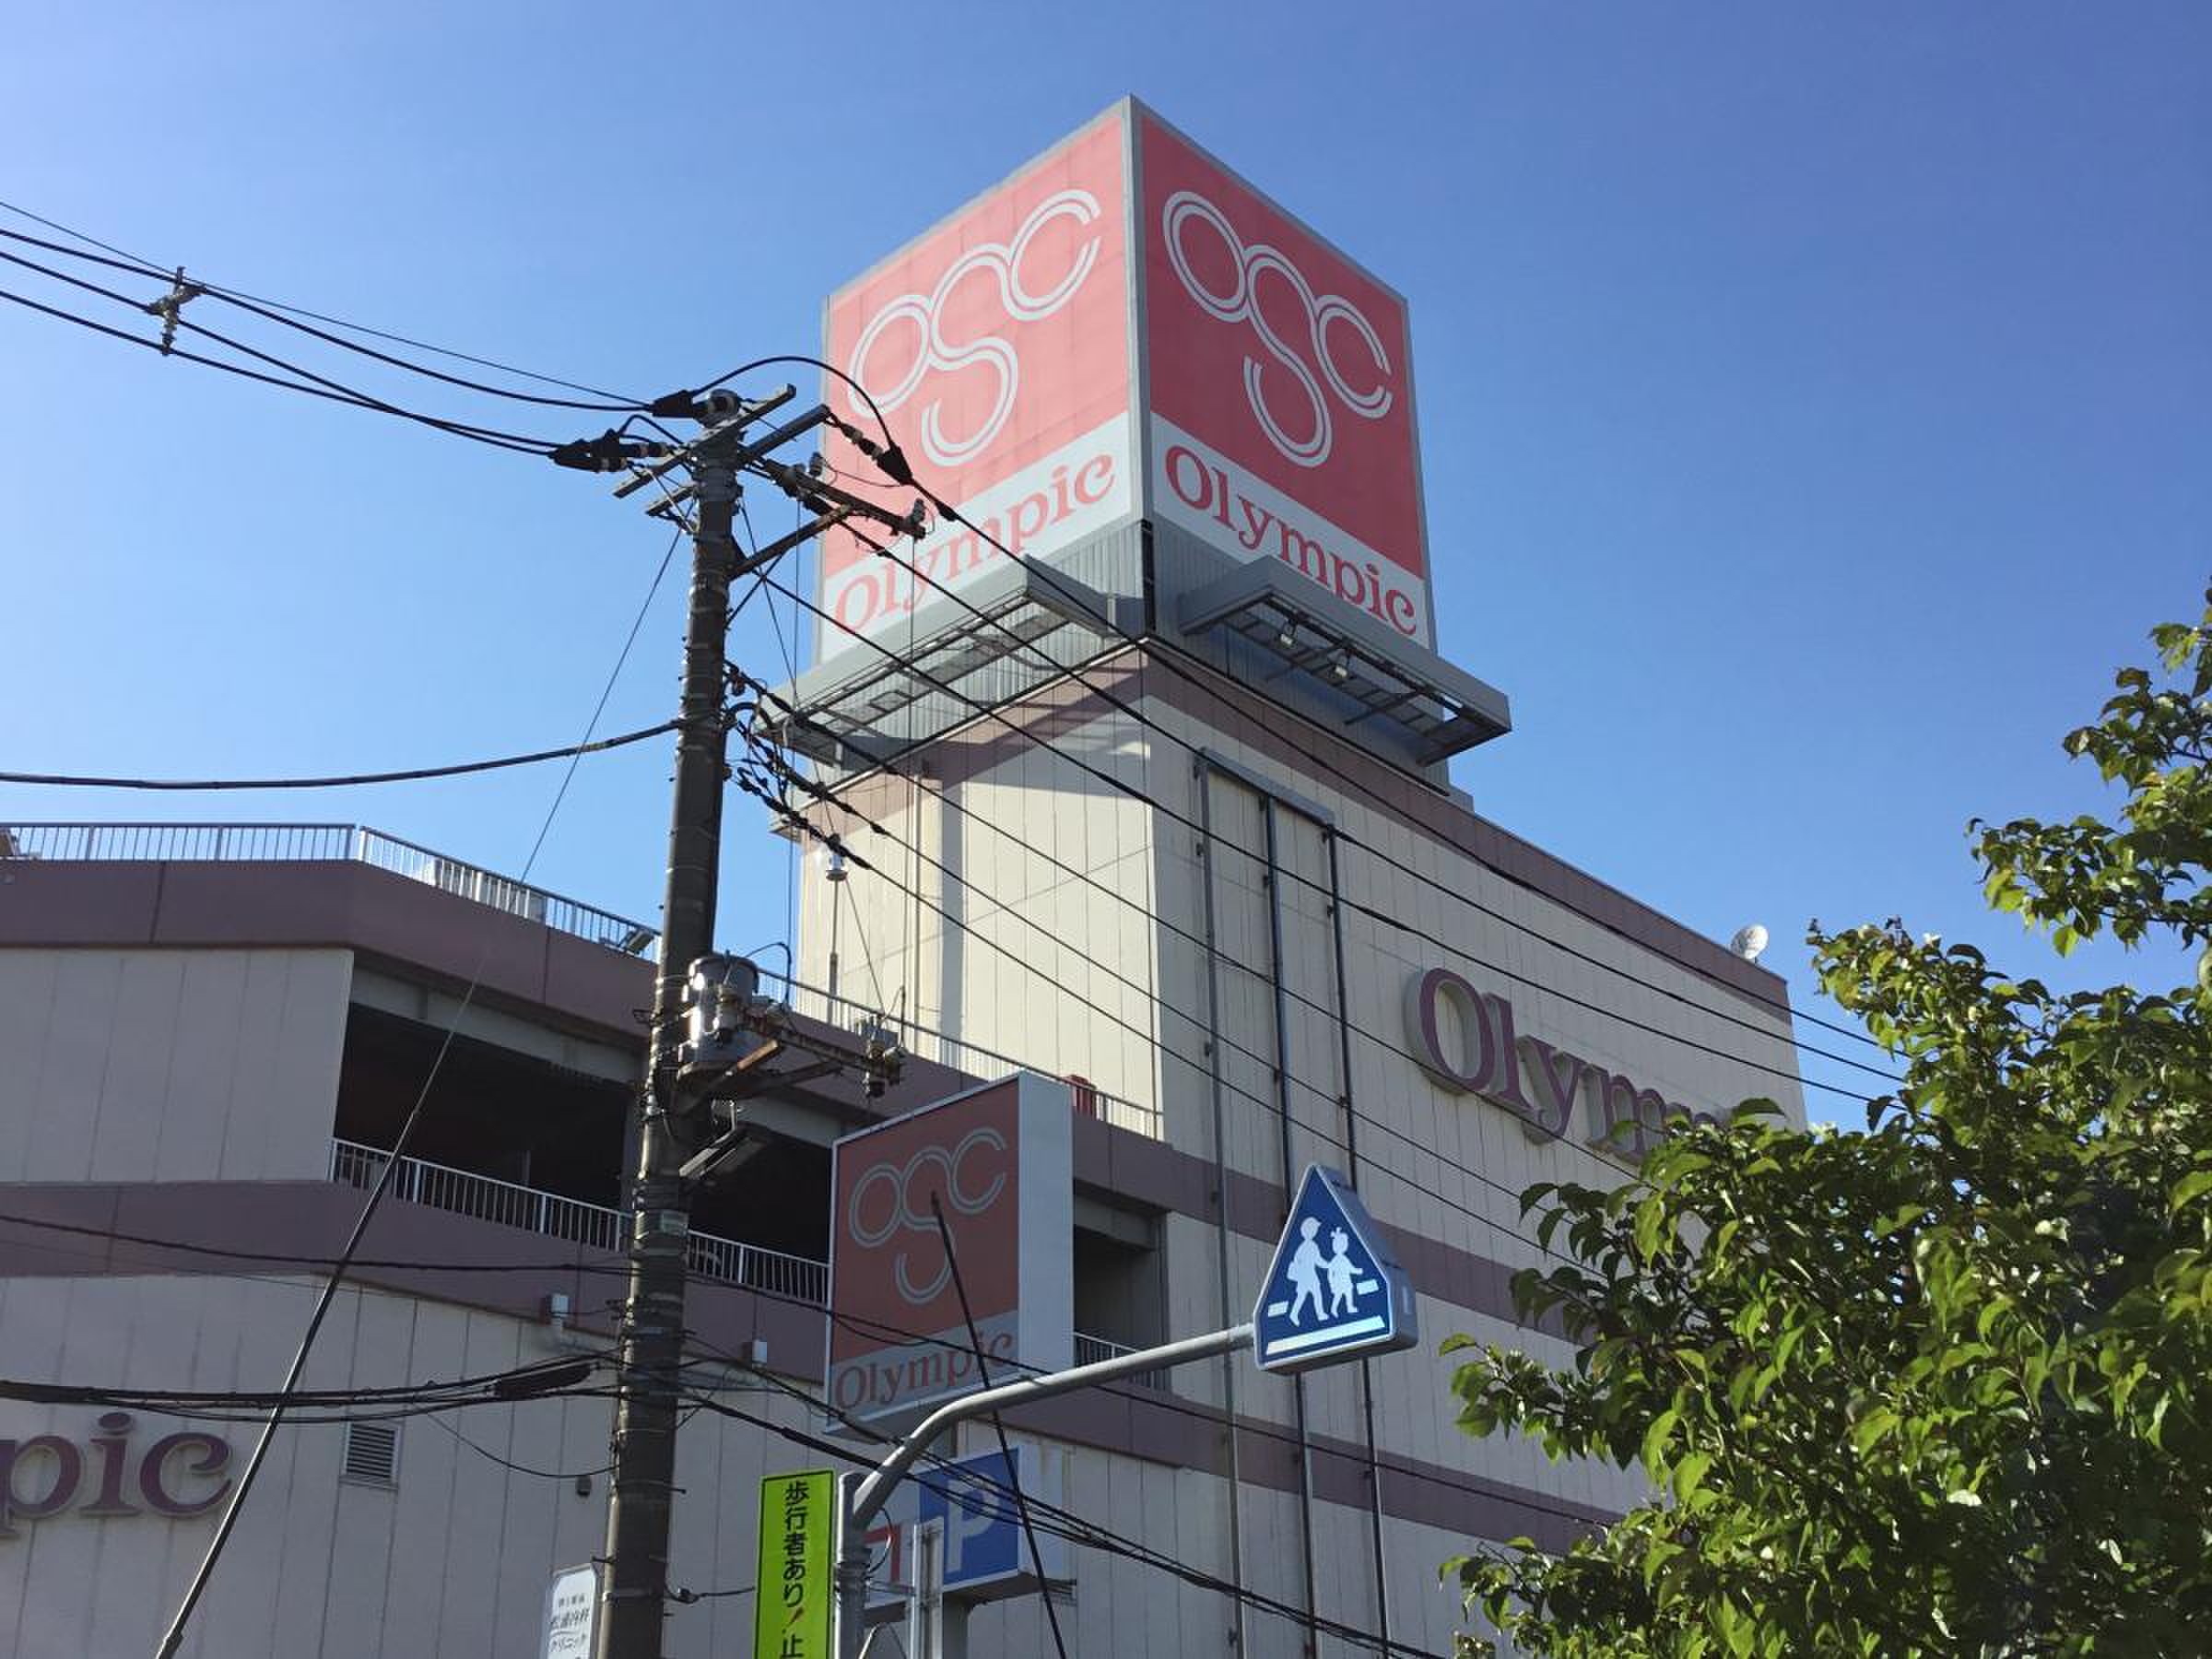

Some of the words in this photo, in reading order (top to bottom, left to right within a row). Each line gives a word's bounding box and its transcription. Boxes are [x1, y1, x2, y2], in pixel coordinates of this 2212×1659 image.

[833, 453, 1115, 634] Olympic
[1164, 444, 1417, 636] Olympic
[1402, 967, 1720, 1169] Olym
[947, 1472, 1002, 1575] P
